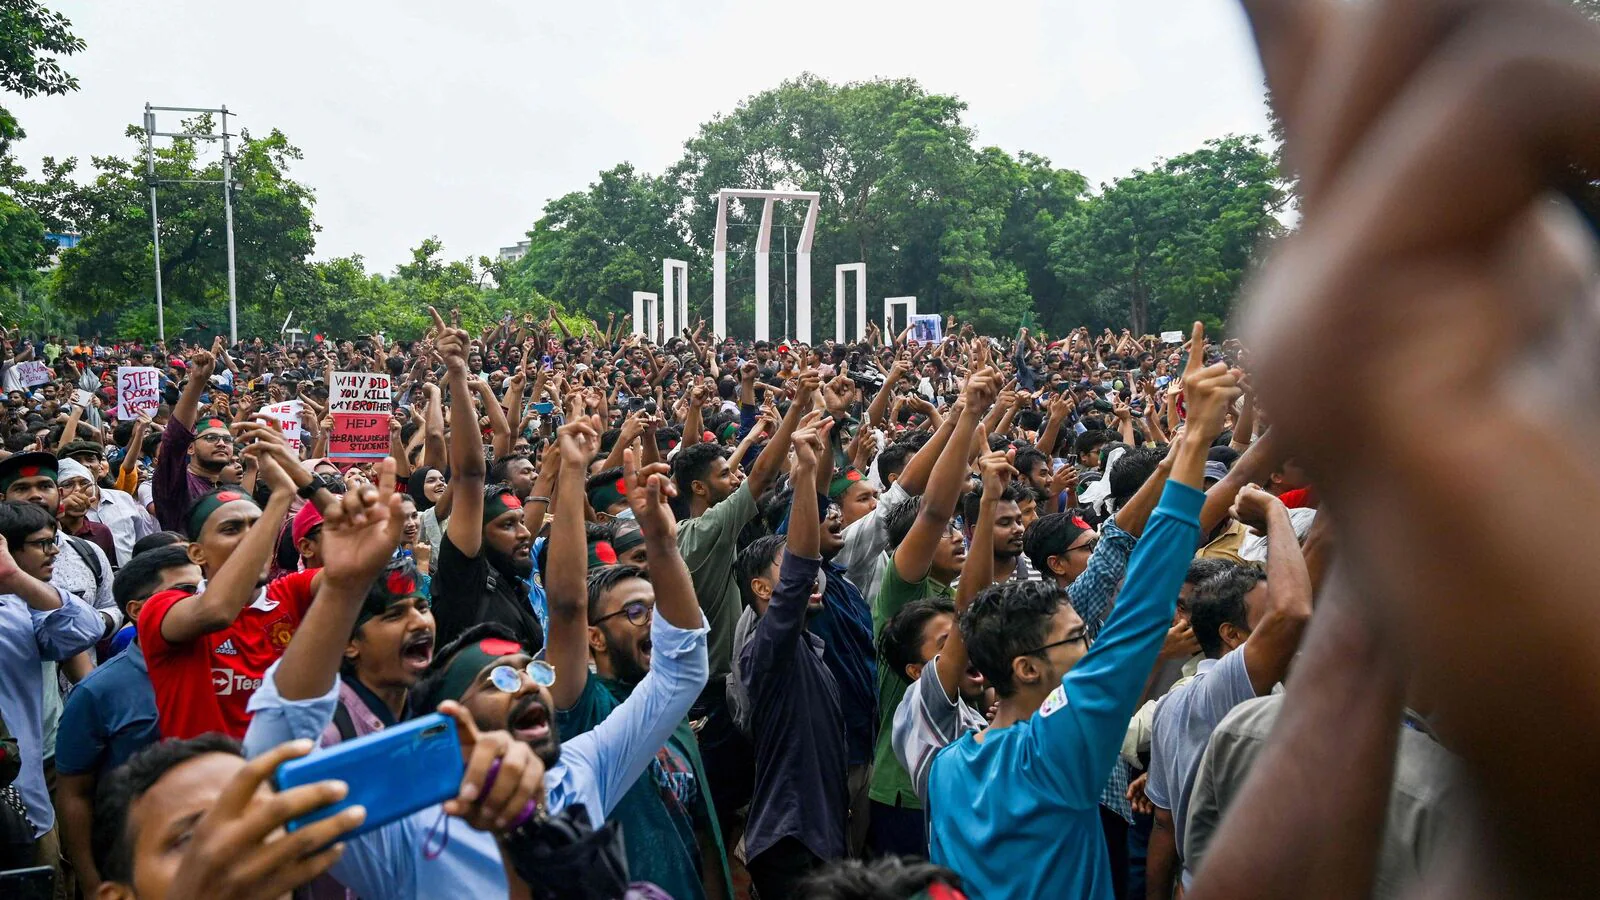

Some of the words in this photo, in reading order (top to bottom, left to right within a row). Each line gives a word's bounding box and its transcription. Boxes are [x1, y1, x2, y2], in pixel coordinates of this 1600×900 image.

[122, 371, 156, 390] STEP
[335, 376, 366, 389] WHY
[368, 377, 389, 389] DID
[122, 388, 157, 401] DOWN
[340, 389, 358, 399] YOU
[363, 389, 390, 400] KILL
[271, 405, 291, 413] WE
[331, 401, 351, 410] MY
[351, 401, 392, 411] BROTHER
[346, 418, 377, 430] HELP
[349, 442, 390, 451] STUDENTS
[215, 647, 237, 655] adidas
